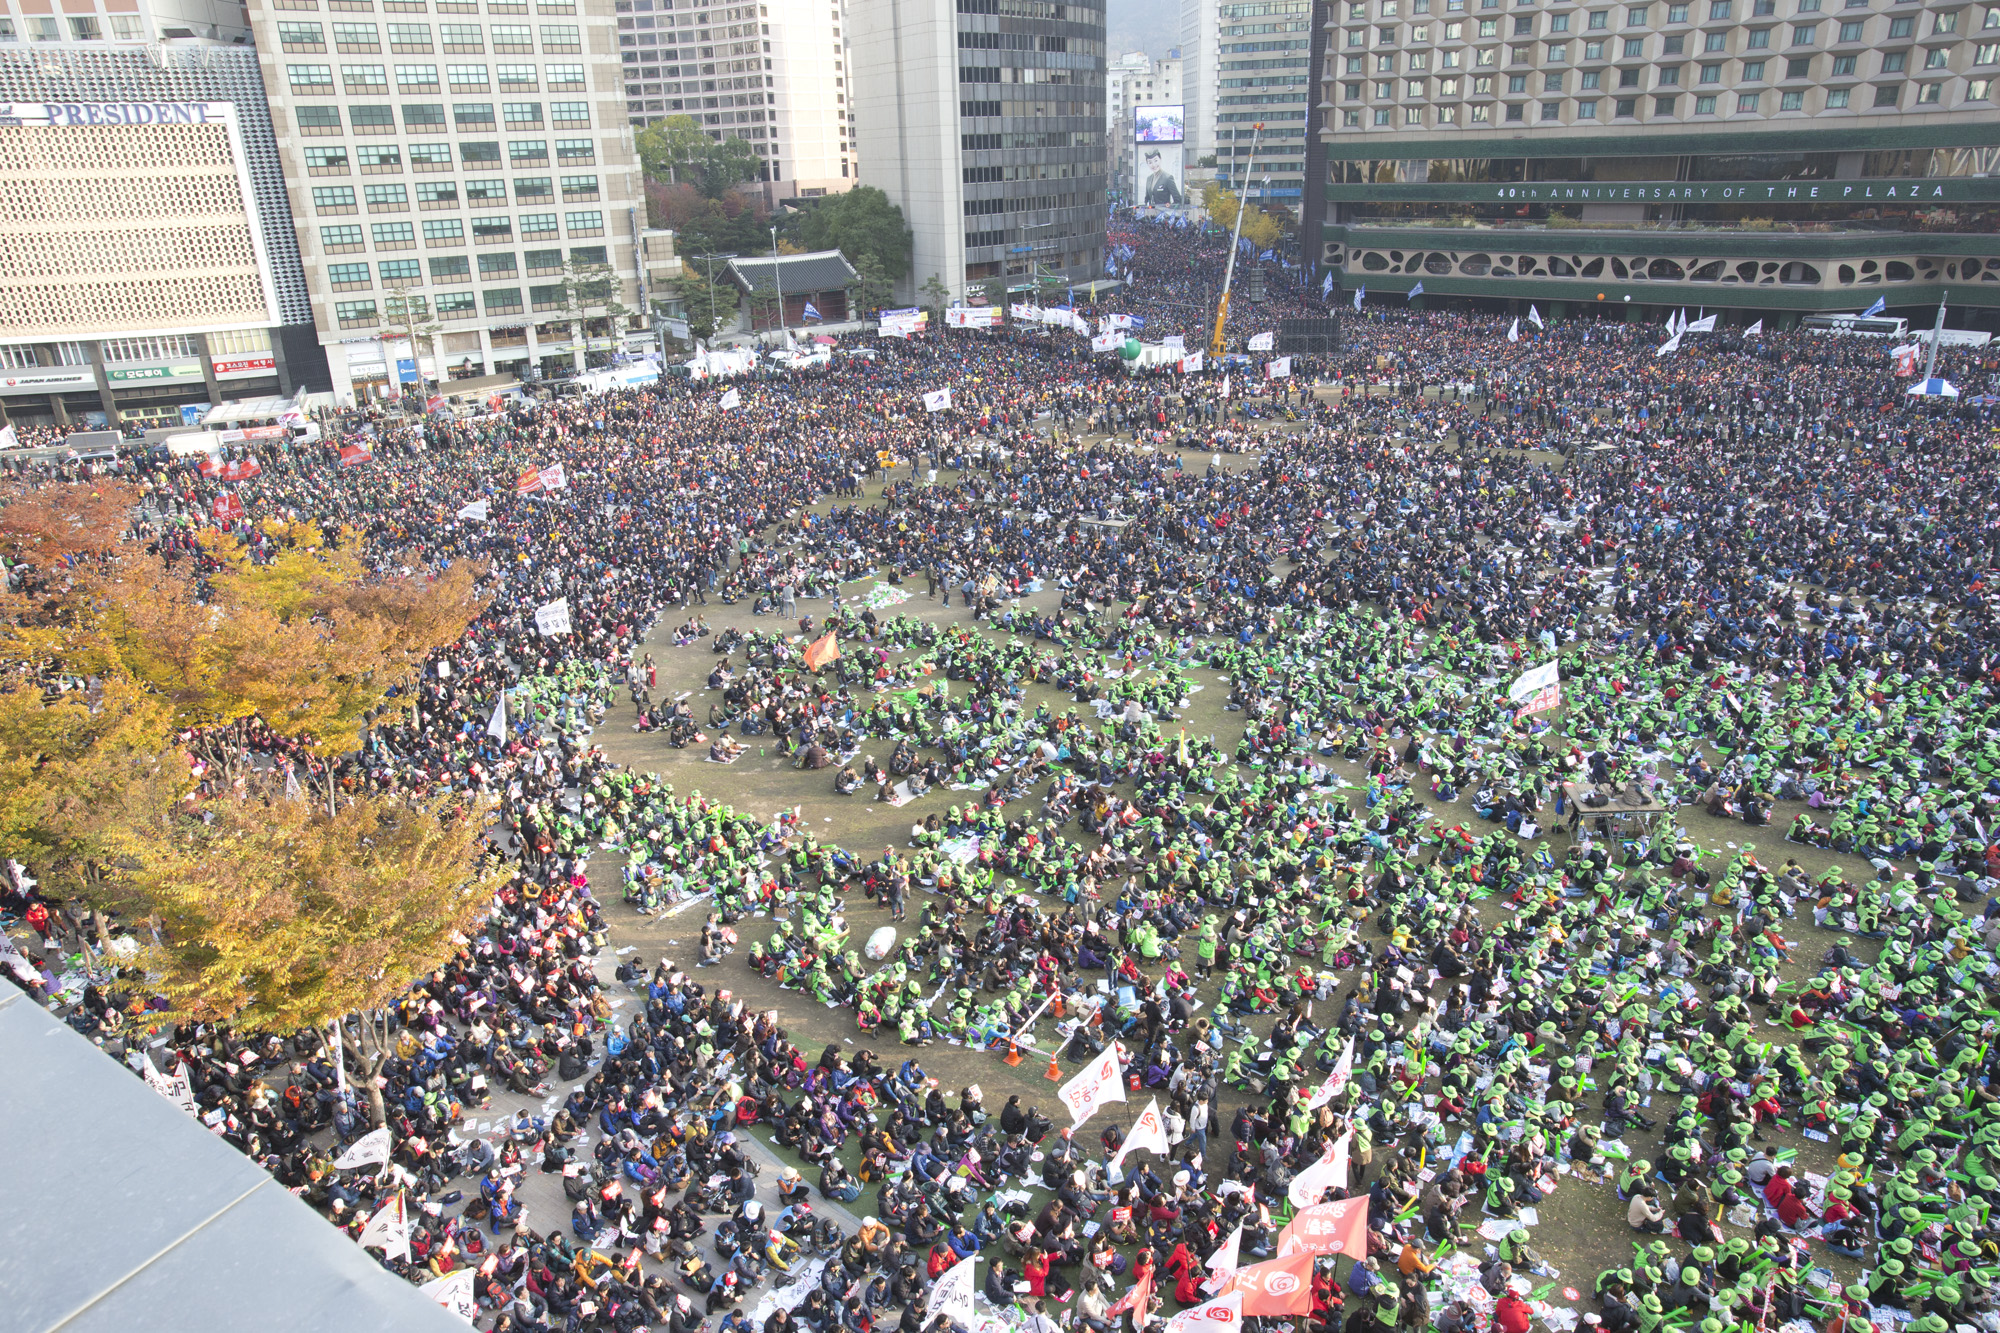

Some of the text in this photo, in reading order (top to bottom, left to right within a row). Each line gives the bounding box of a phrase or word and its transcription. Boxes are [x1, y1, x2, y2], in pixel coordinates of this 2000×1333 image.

[43, 103, 209, 126] PRESIDENT
[1498, 186, 1943, 198] 40th ANNIVERSARY OF THE PLAZA
[126, 369, 163, 379] 모두투어
